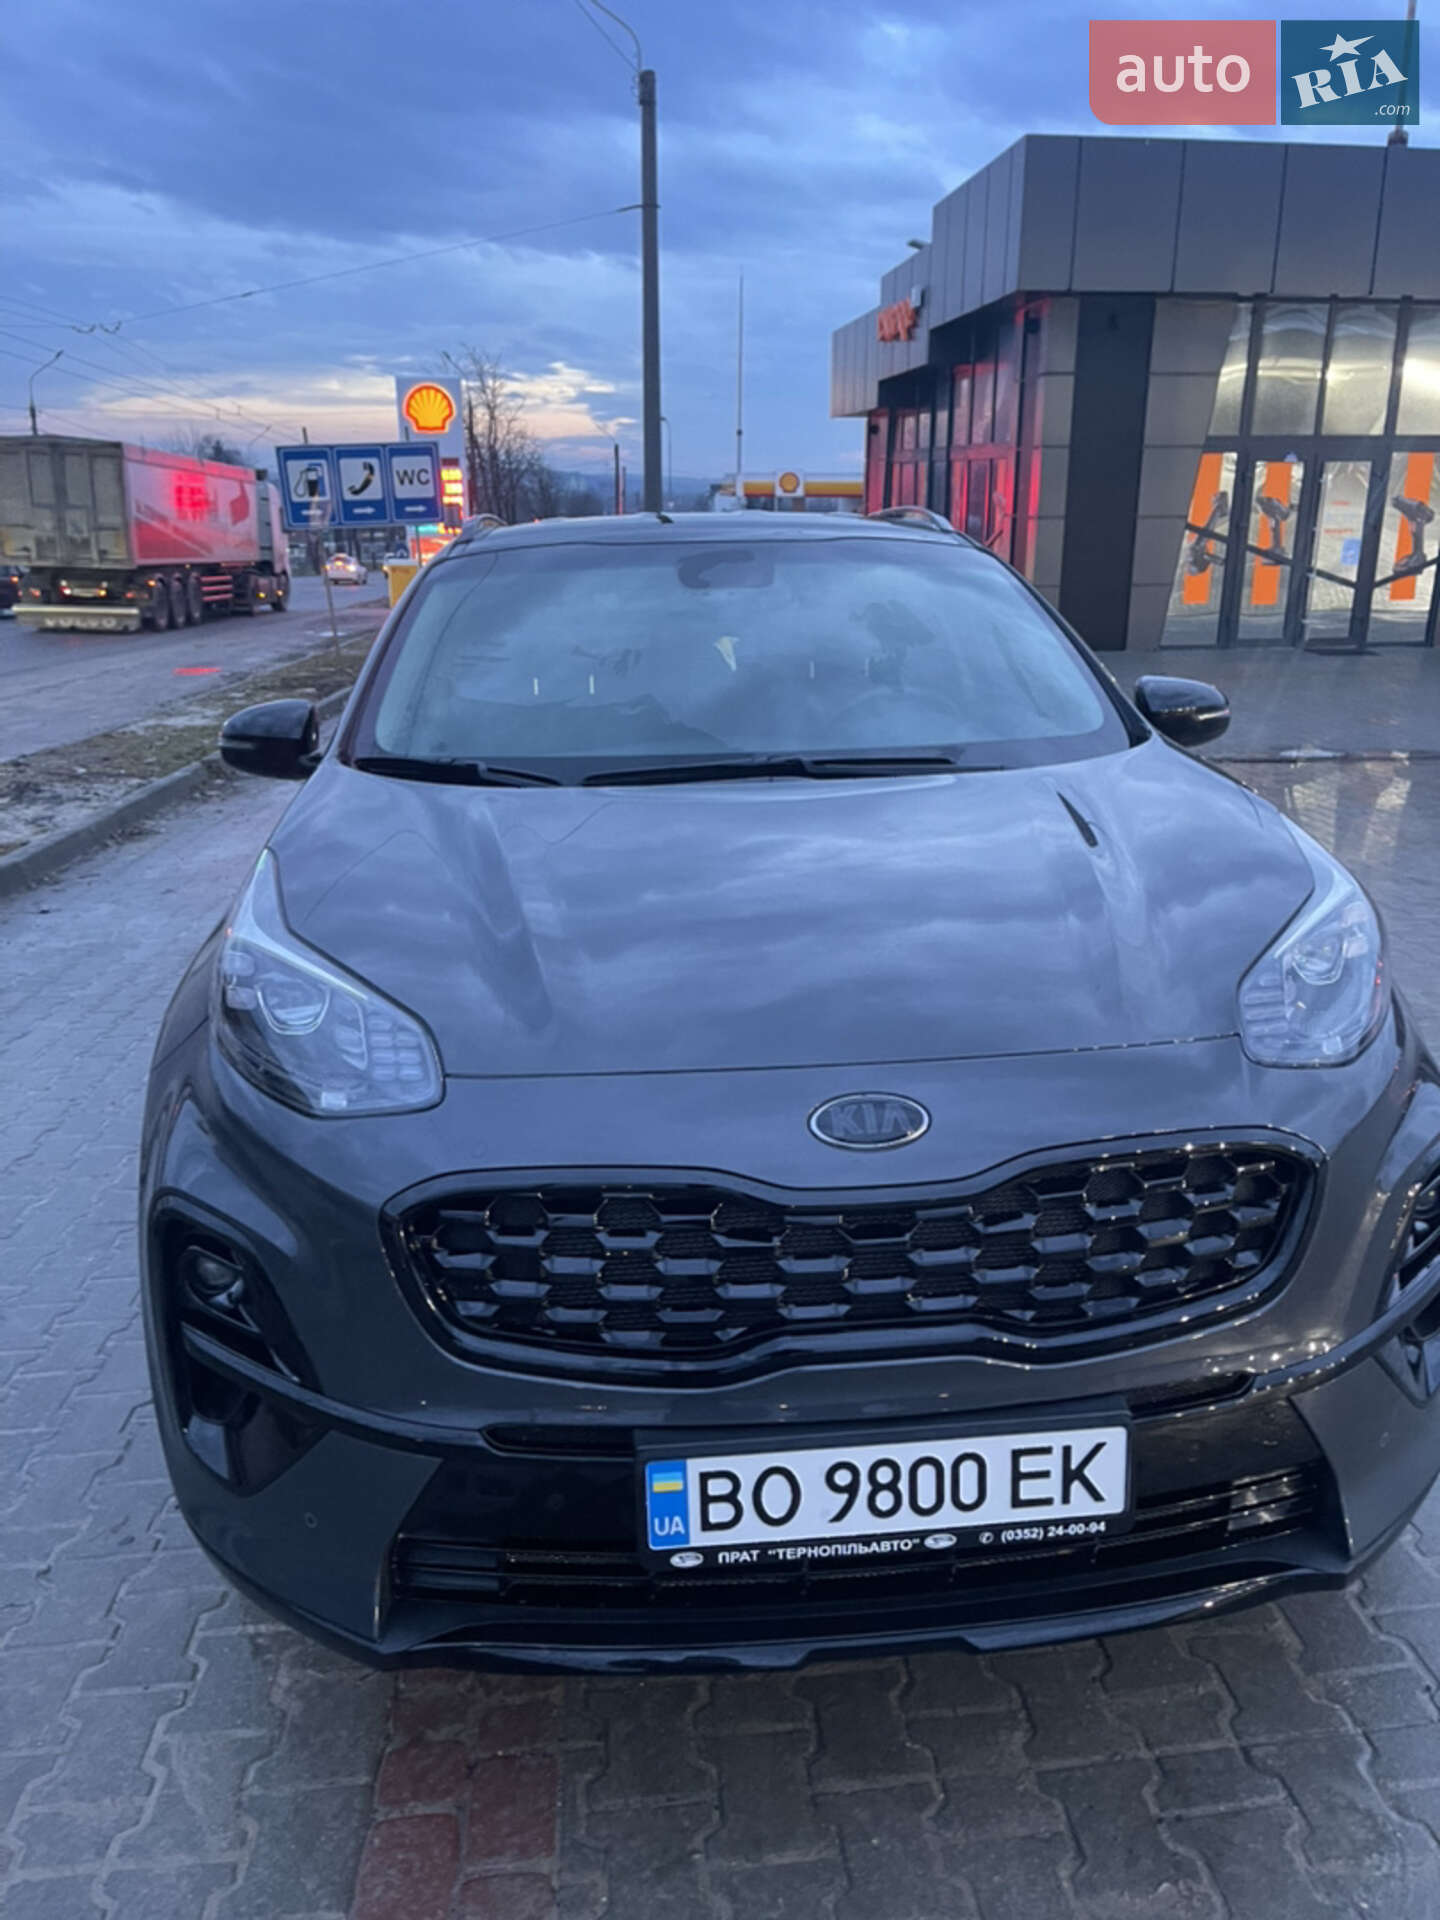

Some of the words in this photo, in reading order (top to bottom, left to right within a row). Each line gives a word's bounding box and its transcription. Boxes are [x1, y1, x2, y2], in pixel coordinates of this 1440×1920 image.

[395, 468, 430, 486] WC
[830, 1102, 915, 1137] KIA
[699, 1465, 802, 1532] BO
[825, 1451, 988, 1523] 9800
[1010, 1441, 1108, 1508] EK
[654, 1516, 686, 1536] UA
[1001, 1526, 1045, 1544] (0352)
[718, 1550, 760, 1564] ПРАТ
